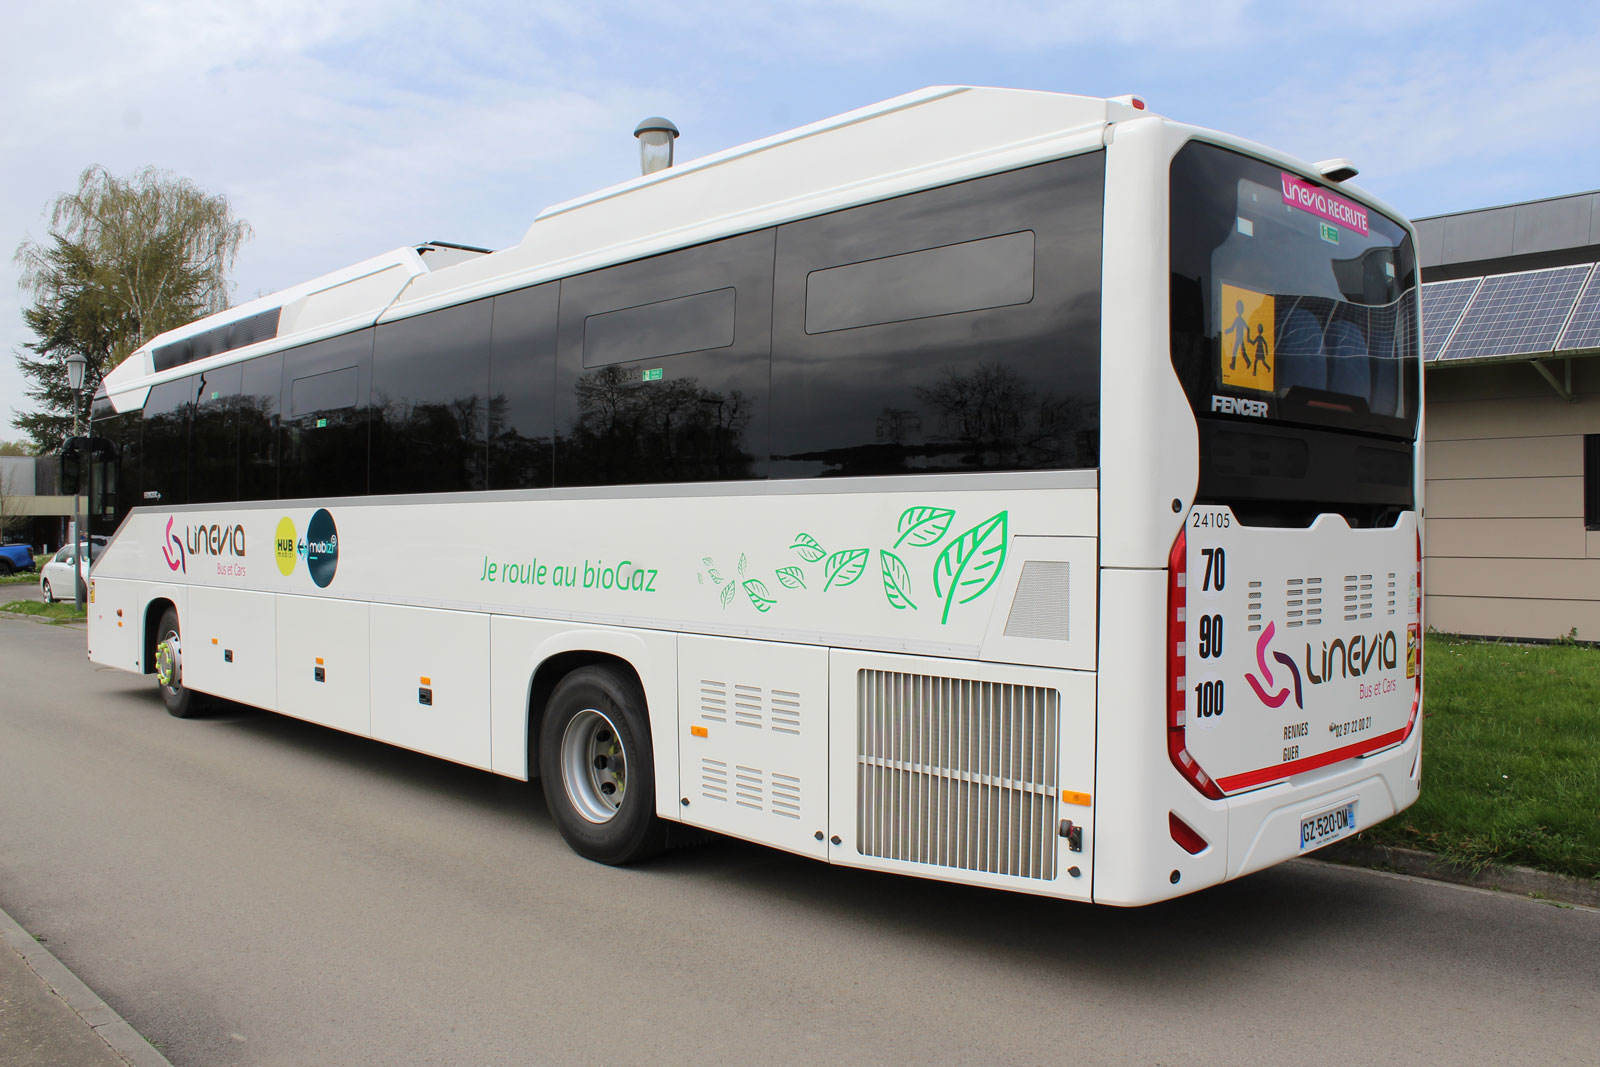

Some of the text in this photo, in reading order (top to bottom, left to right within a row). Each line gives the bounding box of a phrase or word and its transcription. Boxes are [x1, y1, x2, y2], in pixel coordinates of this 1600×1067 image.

[1327, 198, 1368, 232] RECRUTE
[1211, 394, 1268, 418] FENCER
[1192, 512, 1230, 528] 24105
[277, 538, 294, 552] HUB
[216, 562, 246, 577] Bus et Cars
[480, 555, 658, 592] Je roule au bioGaz
[1201, 547, 1225, 592] 70
[1199, 614, 1223, 659] 90
[1195, 679, 1224, 718] 100
[1359, 678, 1396, 700] Bus et Cars
[1283, 721, 1309, 741] RENNES
[1335, 715, 1372, 738] 02 97 22 00 21
[1282, 744, 1300, 762] GUER
